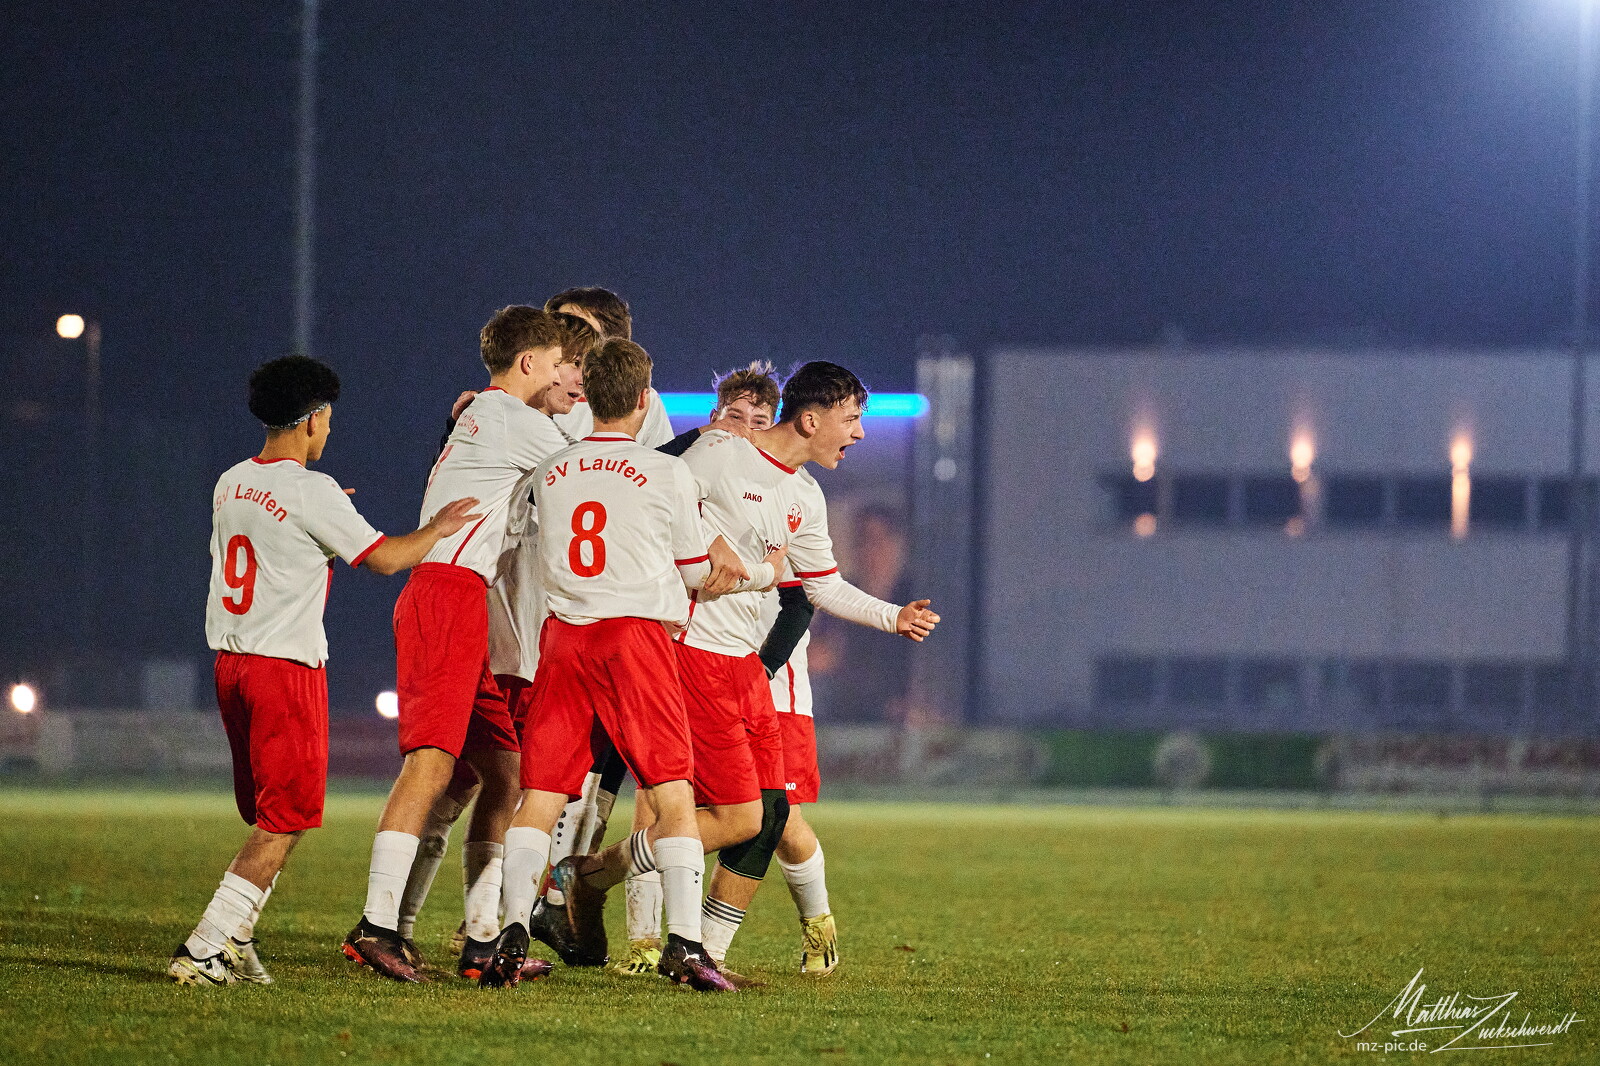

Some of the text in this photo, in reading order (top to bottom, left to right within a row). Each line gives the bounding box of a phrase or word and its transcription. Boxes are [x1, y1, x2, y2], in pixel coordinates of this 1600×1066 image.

[545, 458, 648, 488] SV Laufen
[234, 483, 288, 522] Laufen
[742, 491, 763, 503] JAKO
[568, 501, 608, 578] 8
[222, 534, 258, 616] 9
